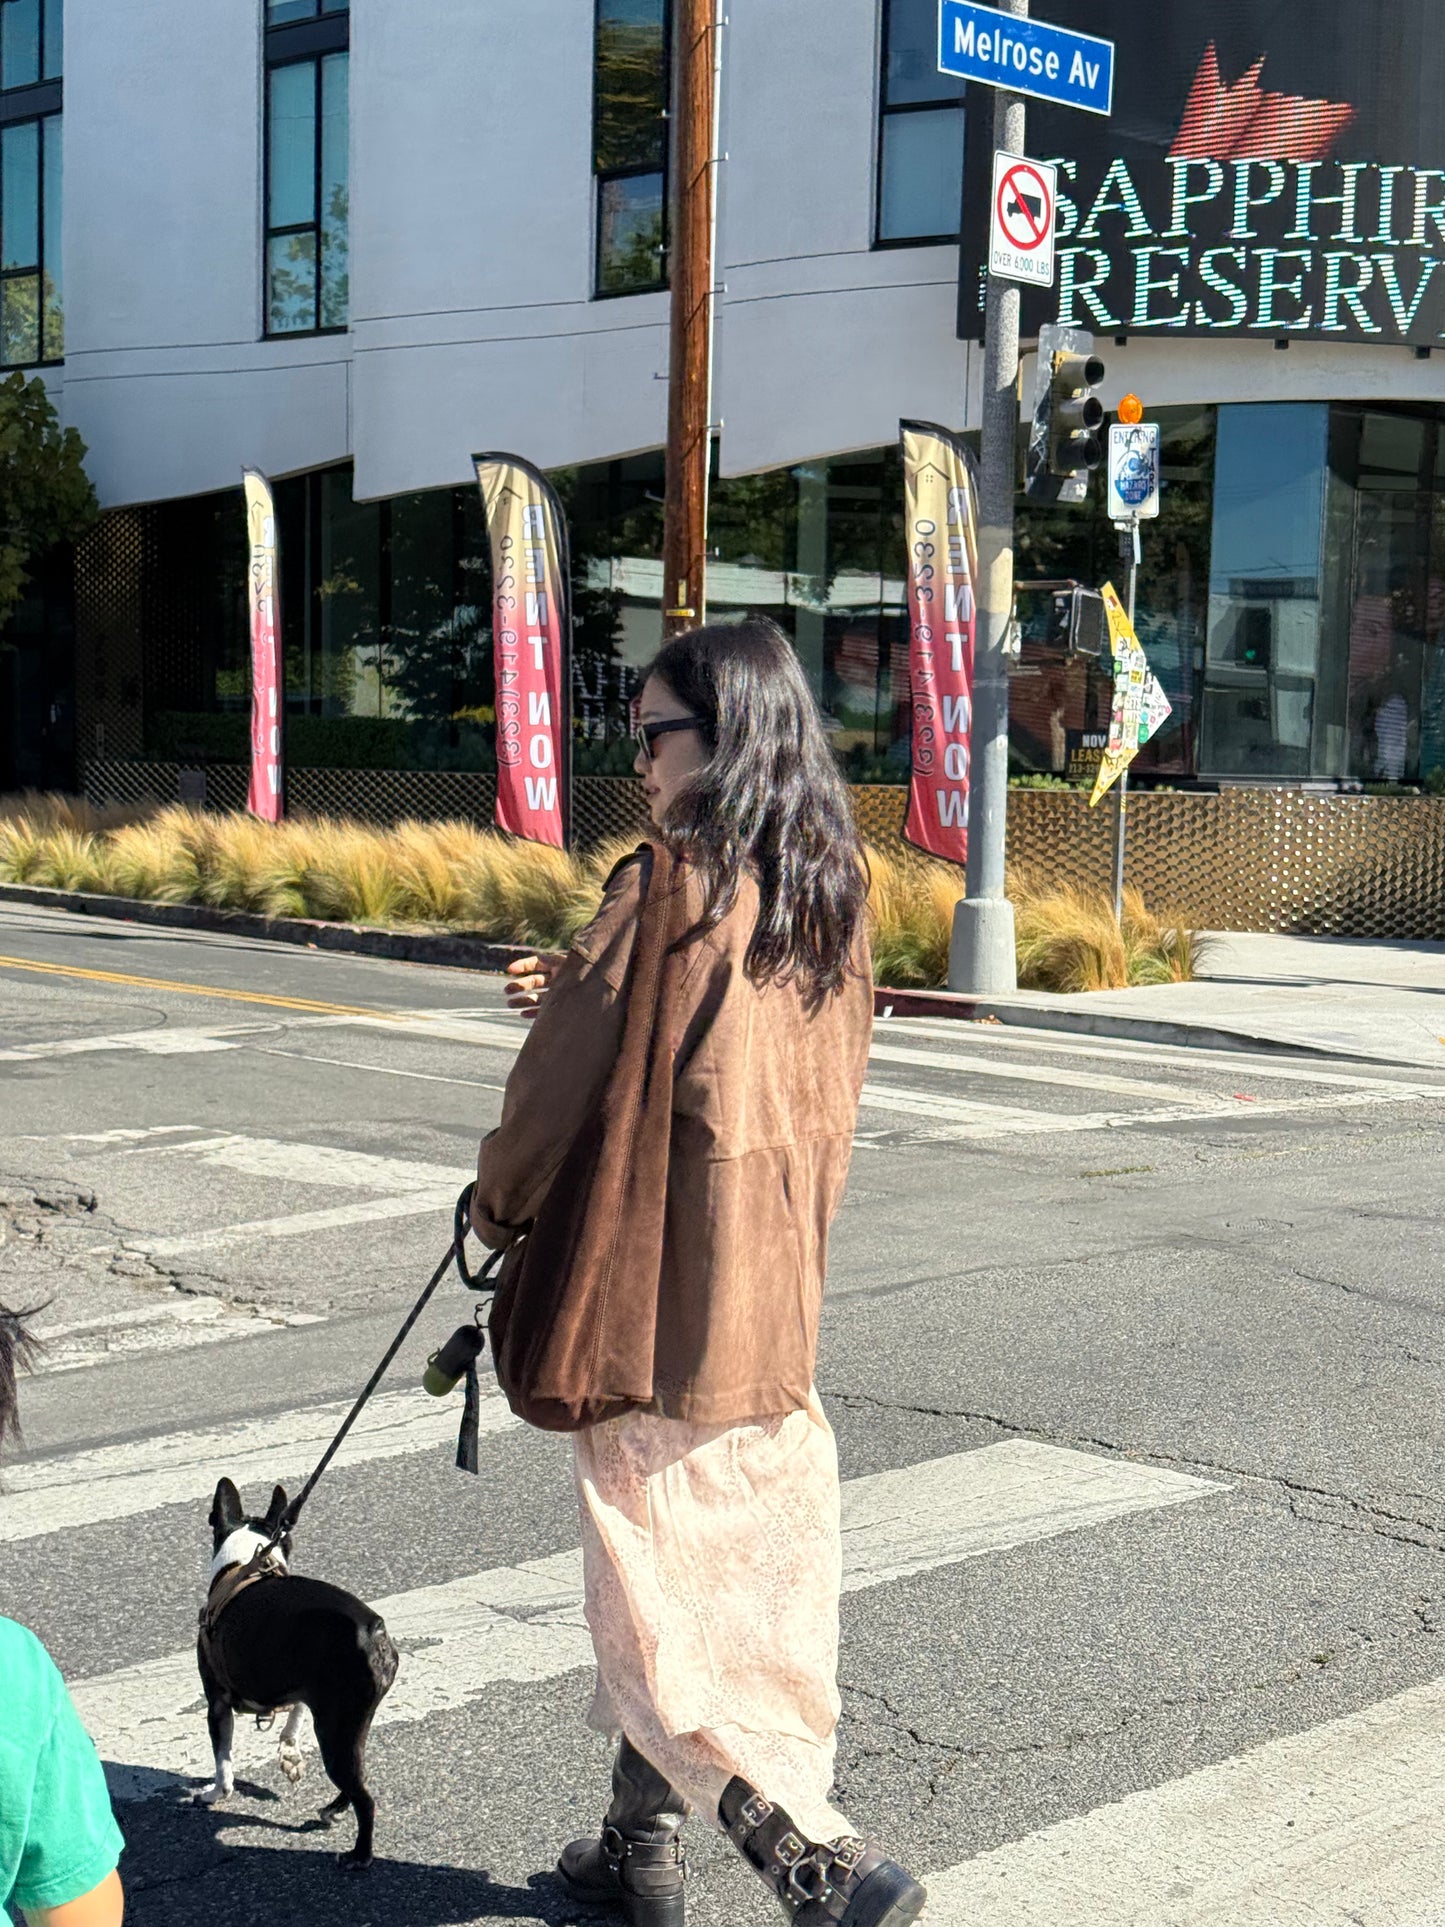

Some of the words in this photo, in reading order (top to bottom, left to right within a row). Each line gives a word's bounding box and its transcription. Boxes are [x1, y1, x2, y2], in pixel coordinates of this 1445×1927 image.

[954, 16, 1060, 80] Melrose
[1068, 50, 1100, 90] Av
[1043, 157, 1445, 248] SAPPHIR
[994, 250, 1011, 267] OVER
[1036, 260, 1050, 276] LBS
[1054, 246, 1445, 338] RESERV
